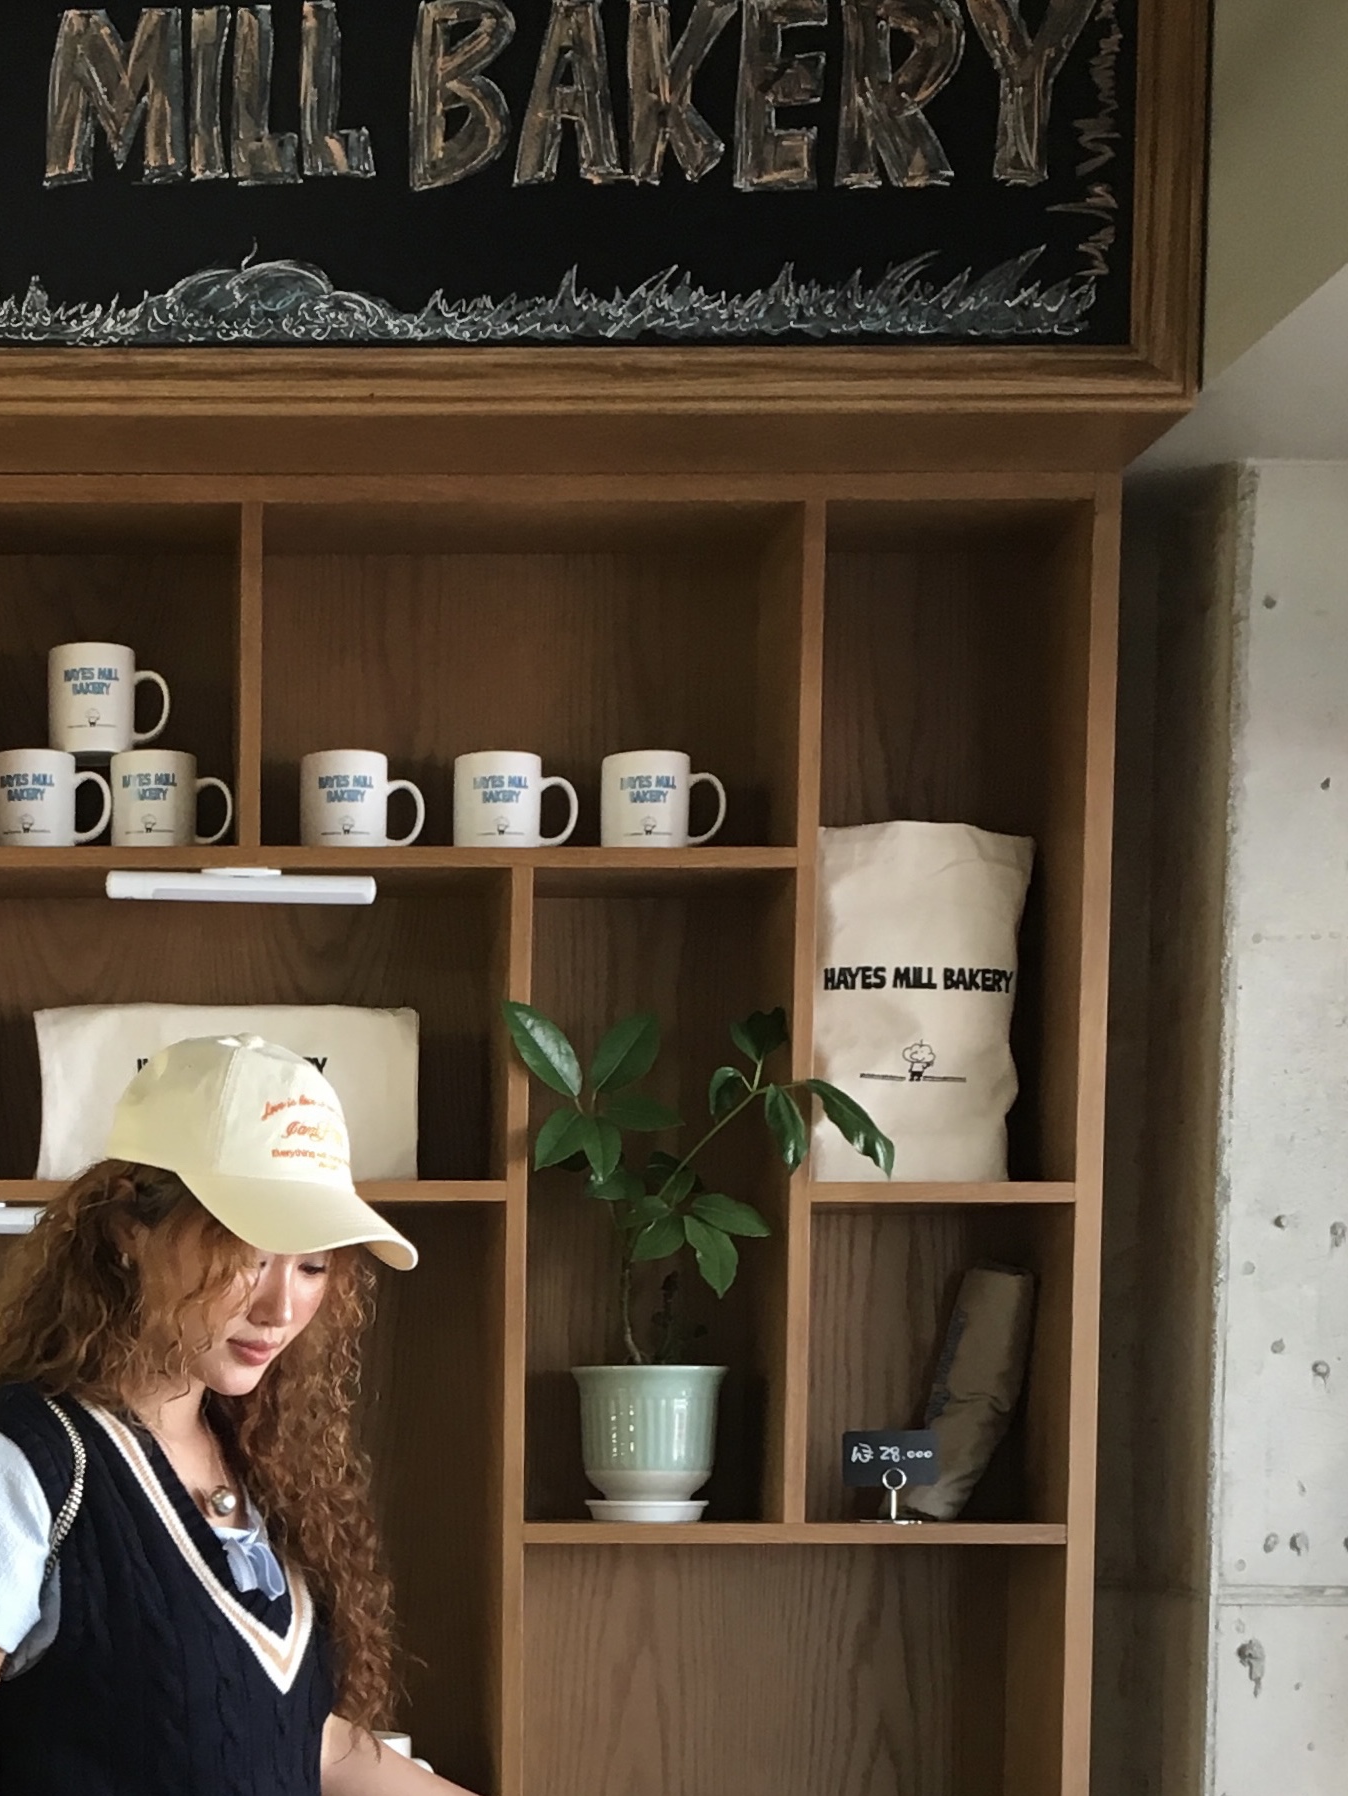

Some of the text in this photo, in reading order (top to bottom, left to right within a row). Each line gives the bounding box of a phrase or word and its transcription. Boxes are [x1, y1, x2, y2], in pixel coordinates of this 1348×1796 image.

[42, 0, 377, 190] MILL
[409, 0, 1101, 192] BAKERY
[122, 773, 151, 788] HYES
[131, 788, 169, 802] AKERY
[823, 966, 1014, 994] HAYES MILL BAKERY
